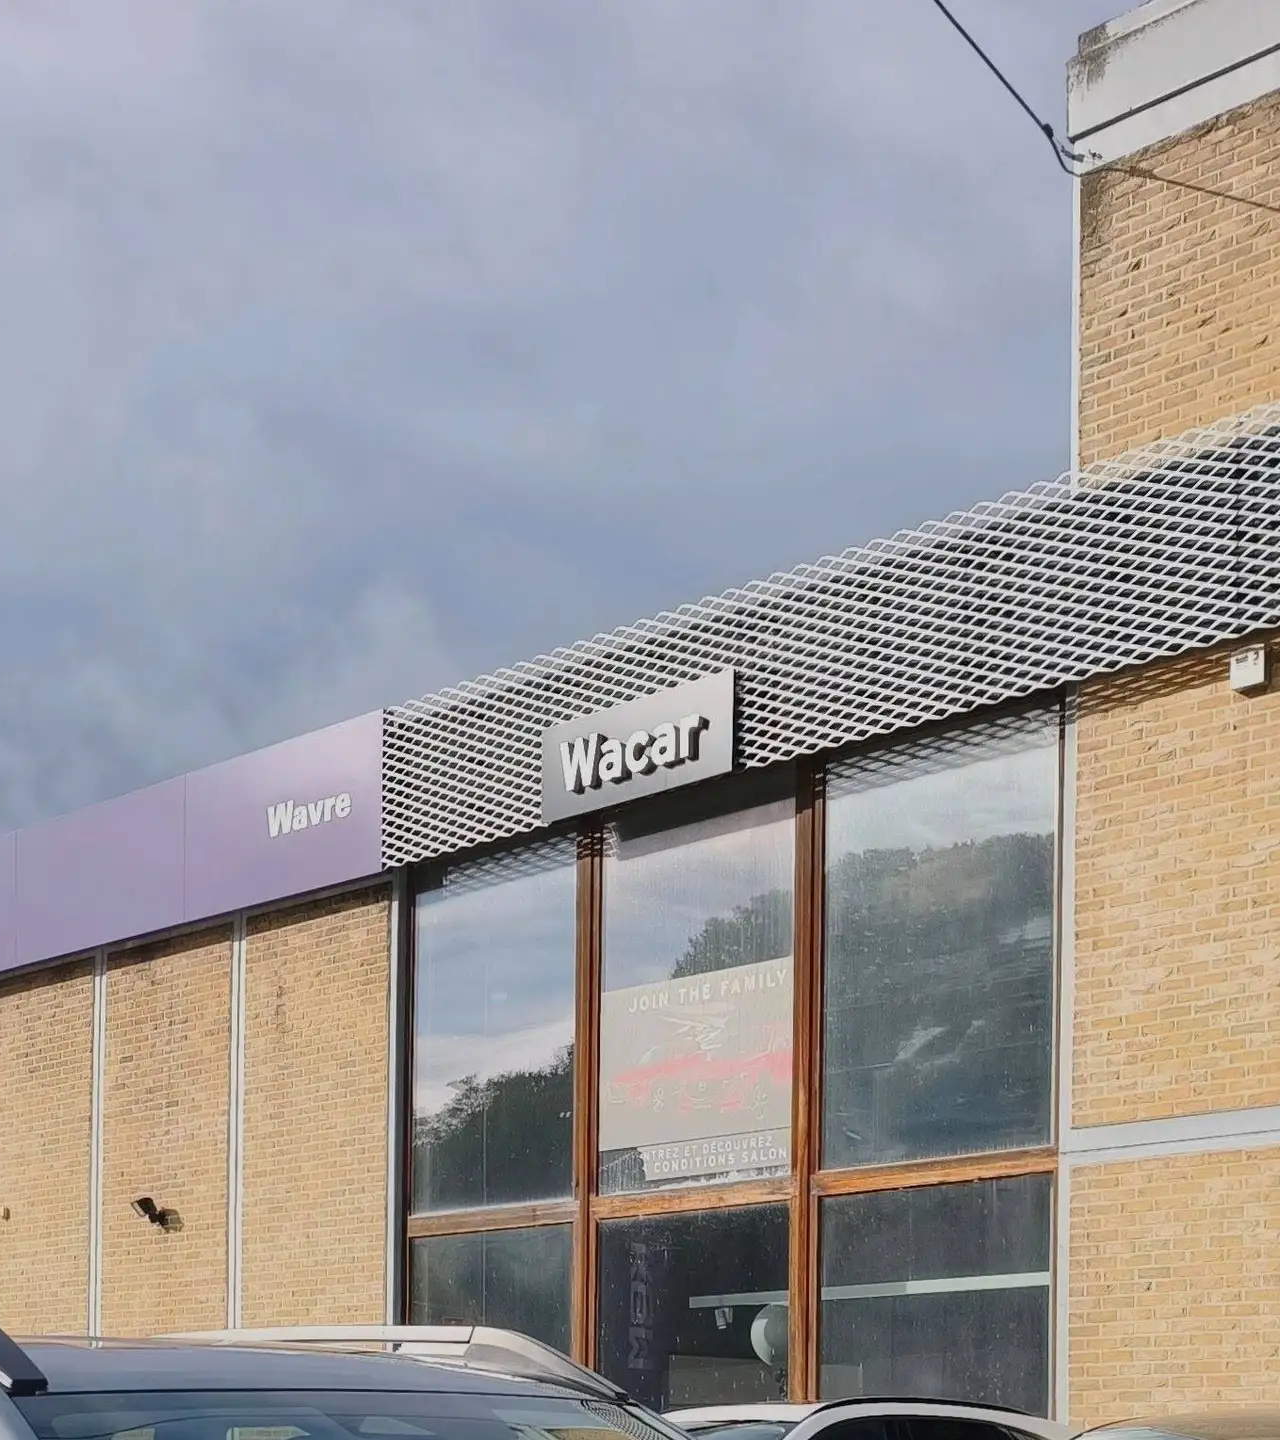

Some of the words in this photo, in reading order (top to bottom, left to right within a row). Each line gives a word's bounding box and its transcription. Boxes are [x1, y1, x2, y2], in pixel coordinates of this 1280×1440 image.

[559, 713, 710, 795] Wacar
[266, 788, 352, 839] Wavre
[628, 990, 669, 1014] JOIN
[678, 983, 713, 1005] THE
[720, 968, 788, 998] FAMILY
[643, 1148, 680, 1162] NTREZ
[684, 1145, 698, 1158] ET
[702, 1135, 773, 1154] DÉCOUVREZ
[654, 1153, 735, 1174] CONDITIONS
[741, 1147, 788, 1163] SALON
